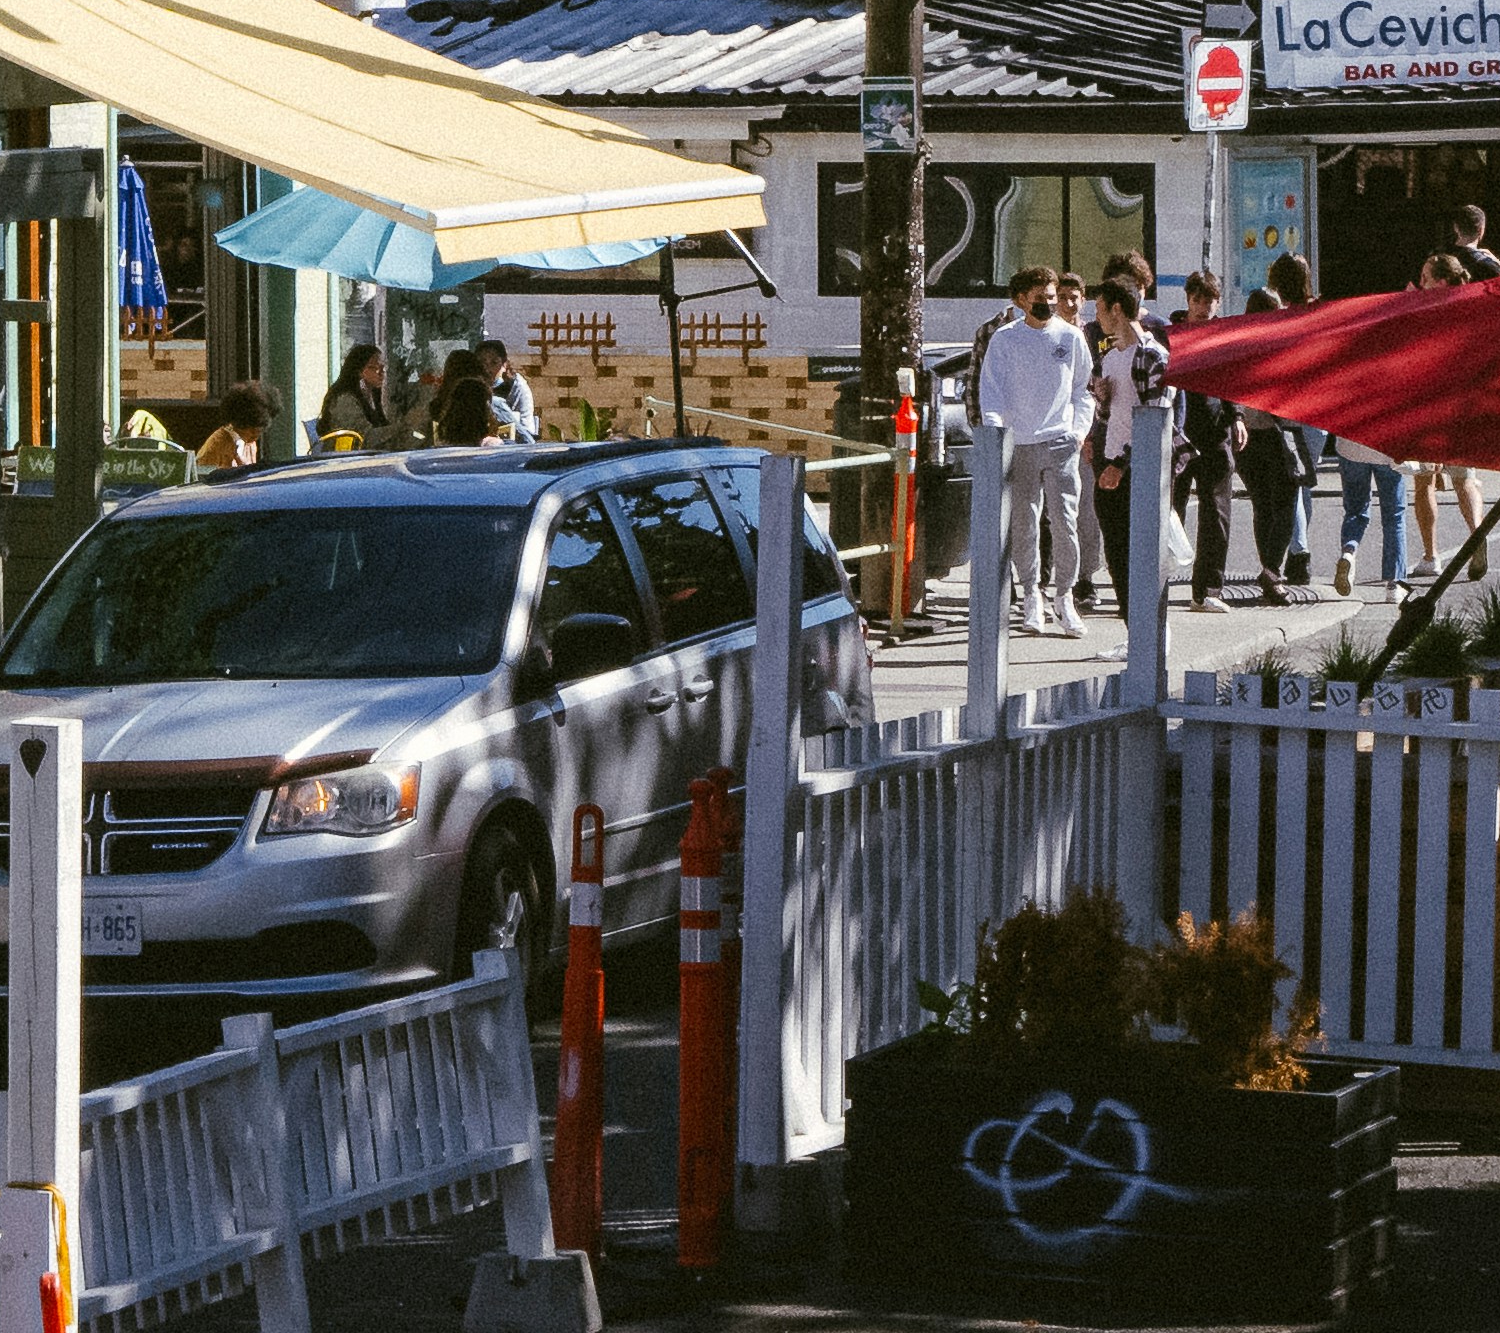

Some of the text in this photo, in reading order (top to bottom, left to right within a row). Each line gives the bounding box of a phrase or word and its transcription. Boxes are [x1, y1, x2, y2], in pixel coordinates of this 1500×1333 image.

[1344, 63, 1397, 82] BAR
[1407, 61, 1460, 78] AND
[147, 457, 176, 480] Sky
